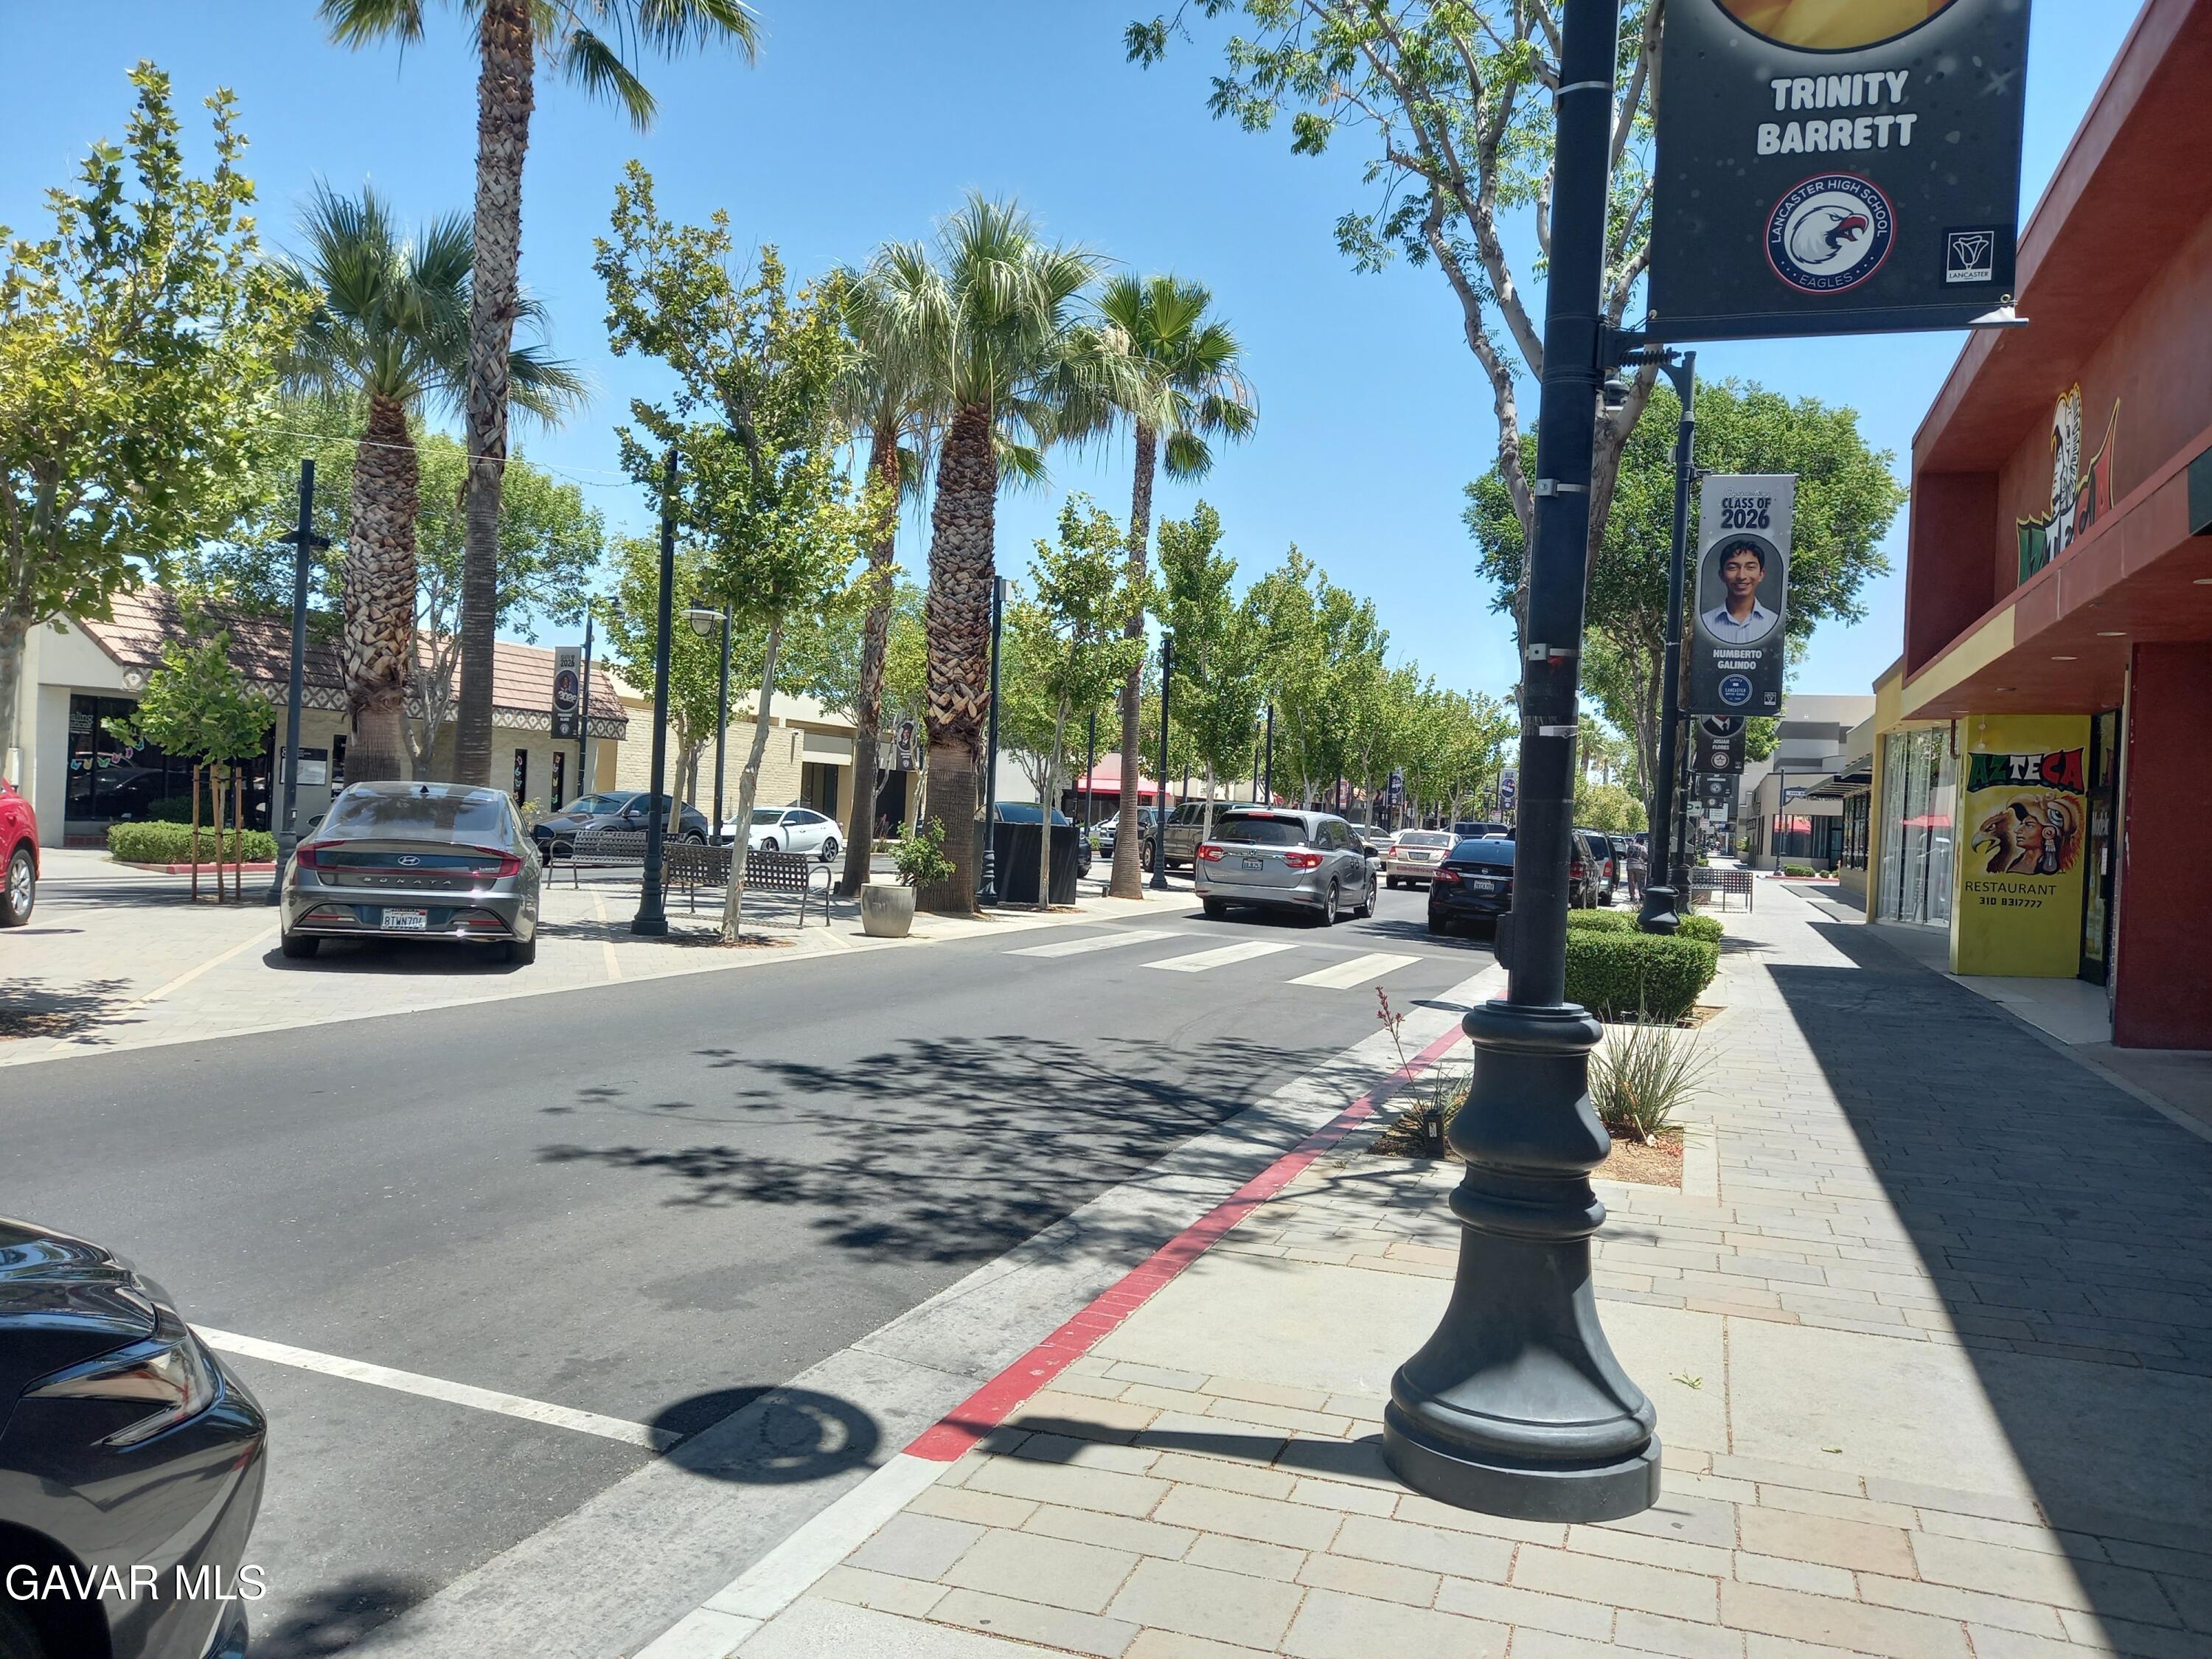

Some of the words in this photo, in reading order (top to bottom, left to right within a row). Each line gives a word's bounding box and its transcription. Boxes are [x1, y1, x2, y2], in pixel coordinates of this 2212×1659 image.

[1771, 70, 1909, 111] TRINITY
[1757, 114, 1917, 156] BARRETT
[1771, 181, 1825, 243] LANCASTER
[1828, 180, 1861, 194] HIGH
[1860, 189, 1888, 237] SCHOOL
[1799, 272, 1853, 288] EAGLES
[1722, 498, 1753, 508] CLASS
[1757, 498, 1771, 508] OF
[1721, 509, 1770, 529] 2026
[1713, 650, 1762, 658] HUMBERTO
[560, 659, 575, 667] 2026
[1717, 661, 1756, 669] GALINDO
[1968, 748, 2084, 793] AZTECA
[1965, 881, 2057, 895] RESTAURANT
[1980, 897, 1997, 905] 310
[2001, 898, 2042, 908] 8317777
